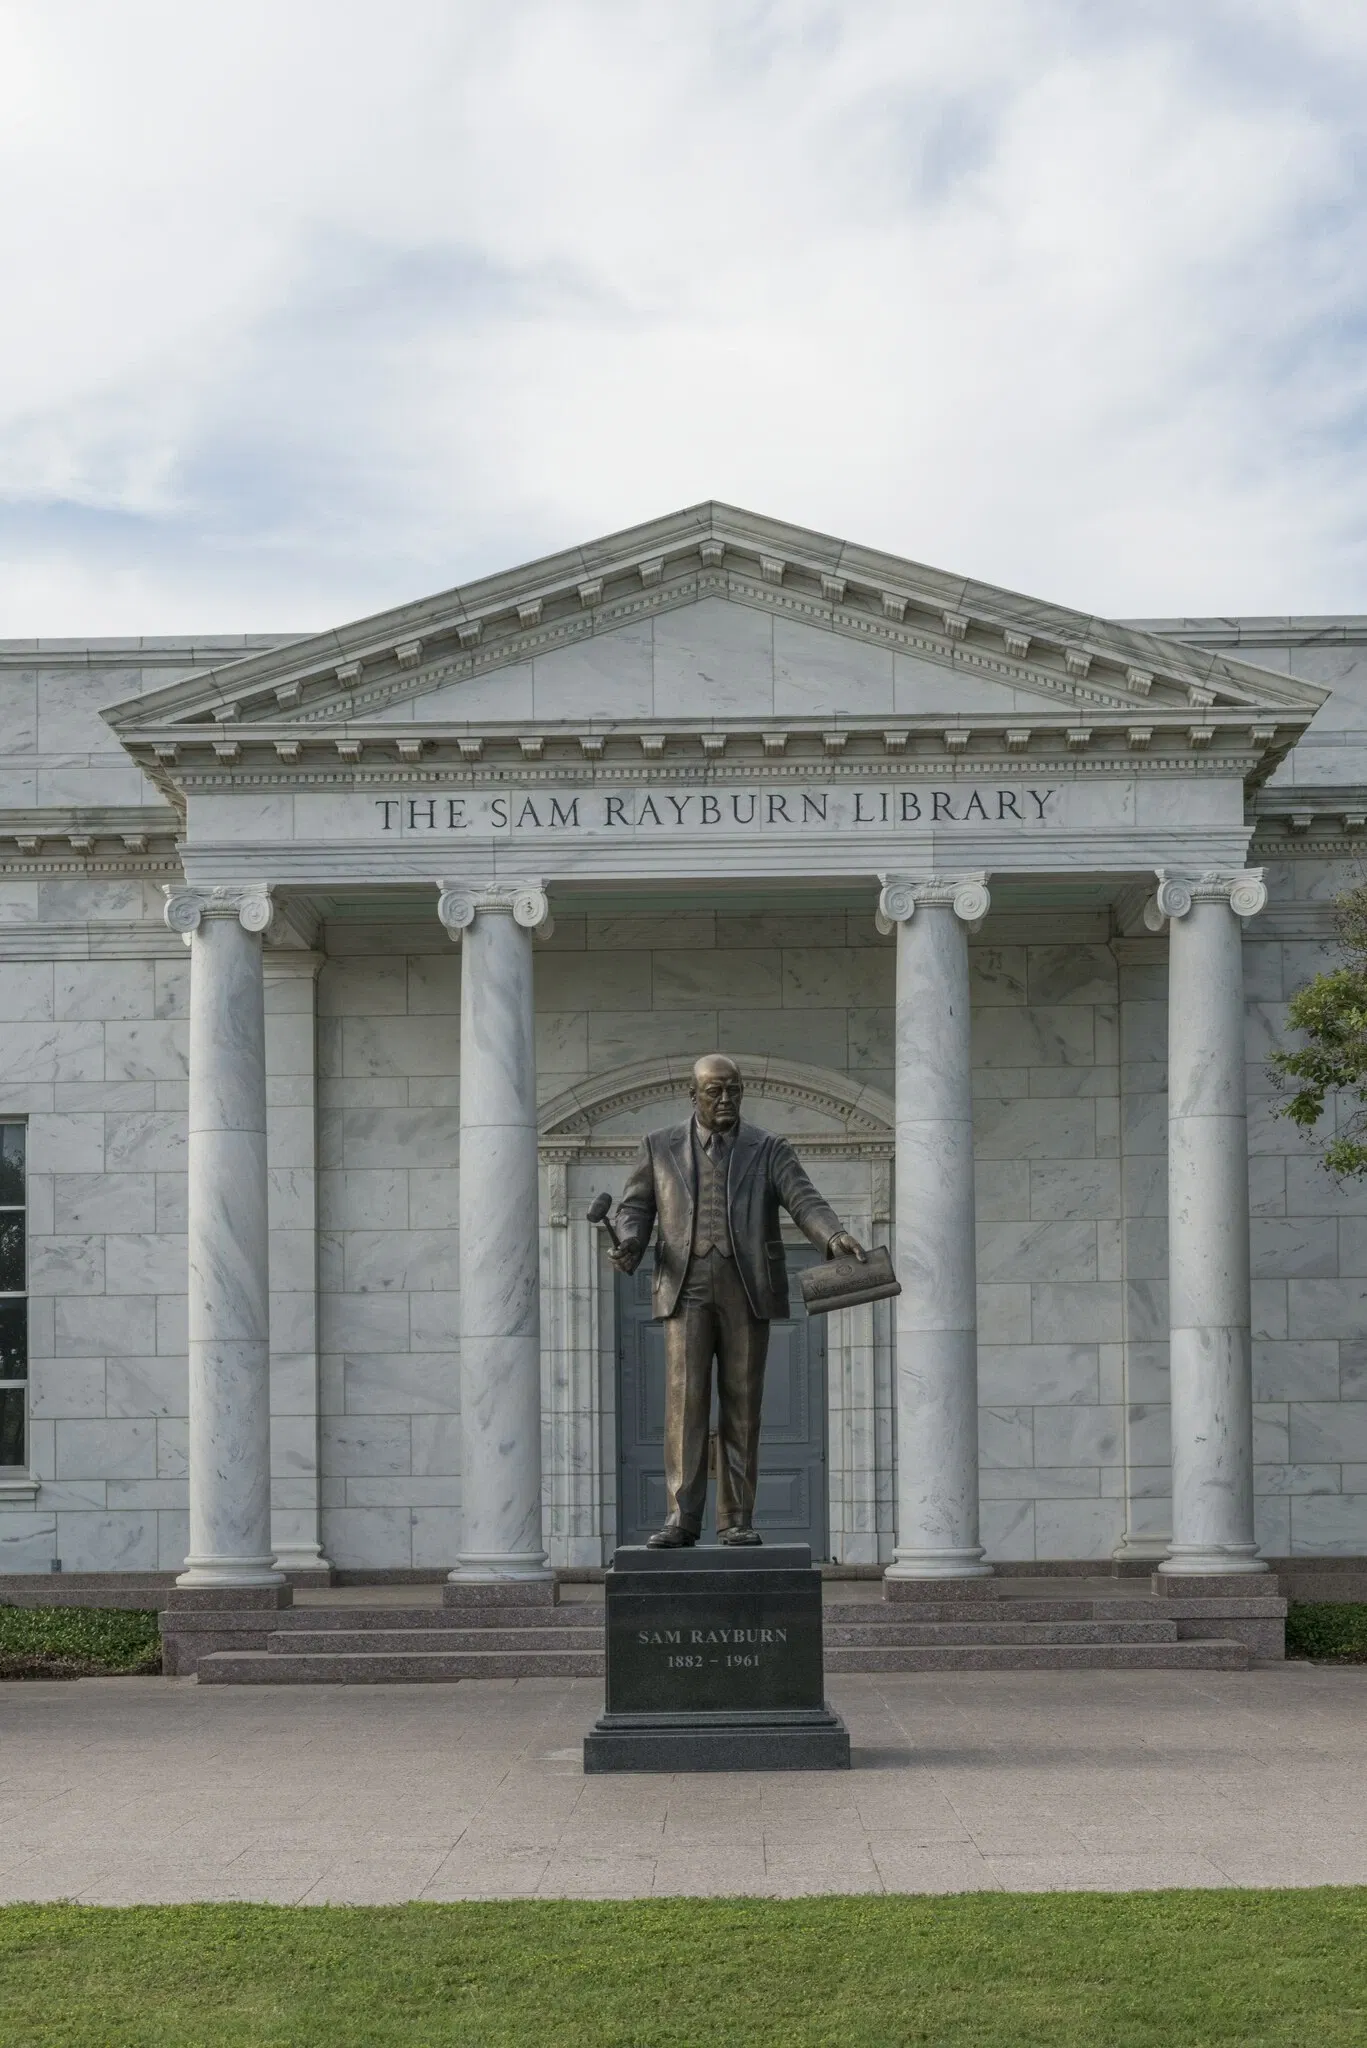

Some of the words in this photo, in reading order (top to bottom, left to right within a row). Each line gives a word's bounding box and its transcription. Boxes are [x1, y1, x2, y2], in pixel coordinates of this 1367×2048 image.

[375, 800, 468, 830] THE
[491, 797, 581, 828] SAM
[603, 793, 829, 826] RAYBURN
[852, 789, 1056, 823] LIBRARY
[639, 1630, 681, 1644] SAM
[691, 1629, 788, 1643] RAYBURN
[668, 1655, 703, 1668] 1882
[726, 1654, 759, 1667] 1961
